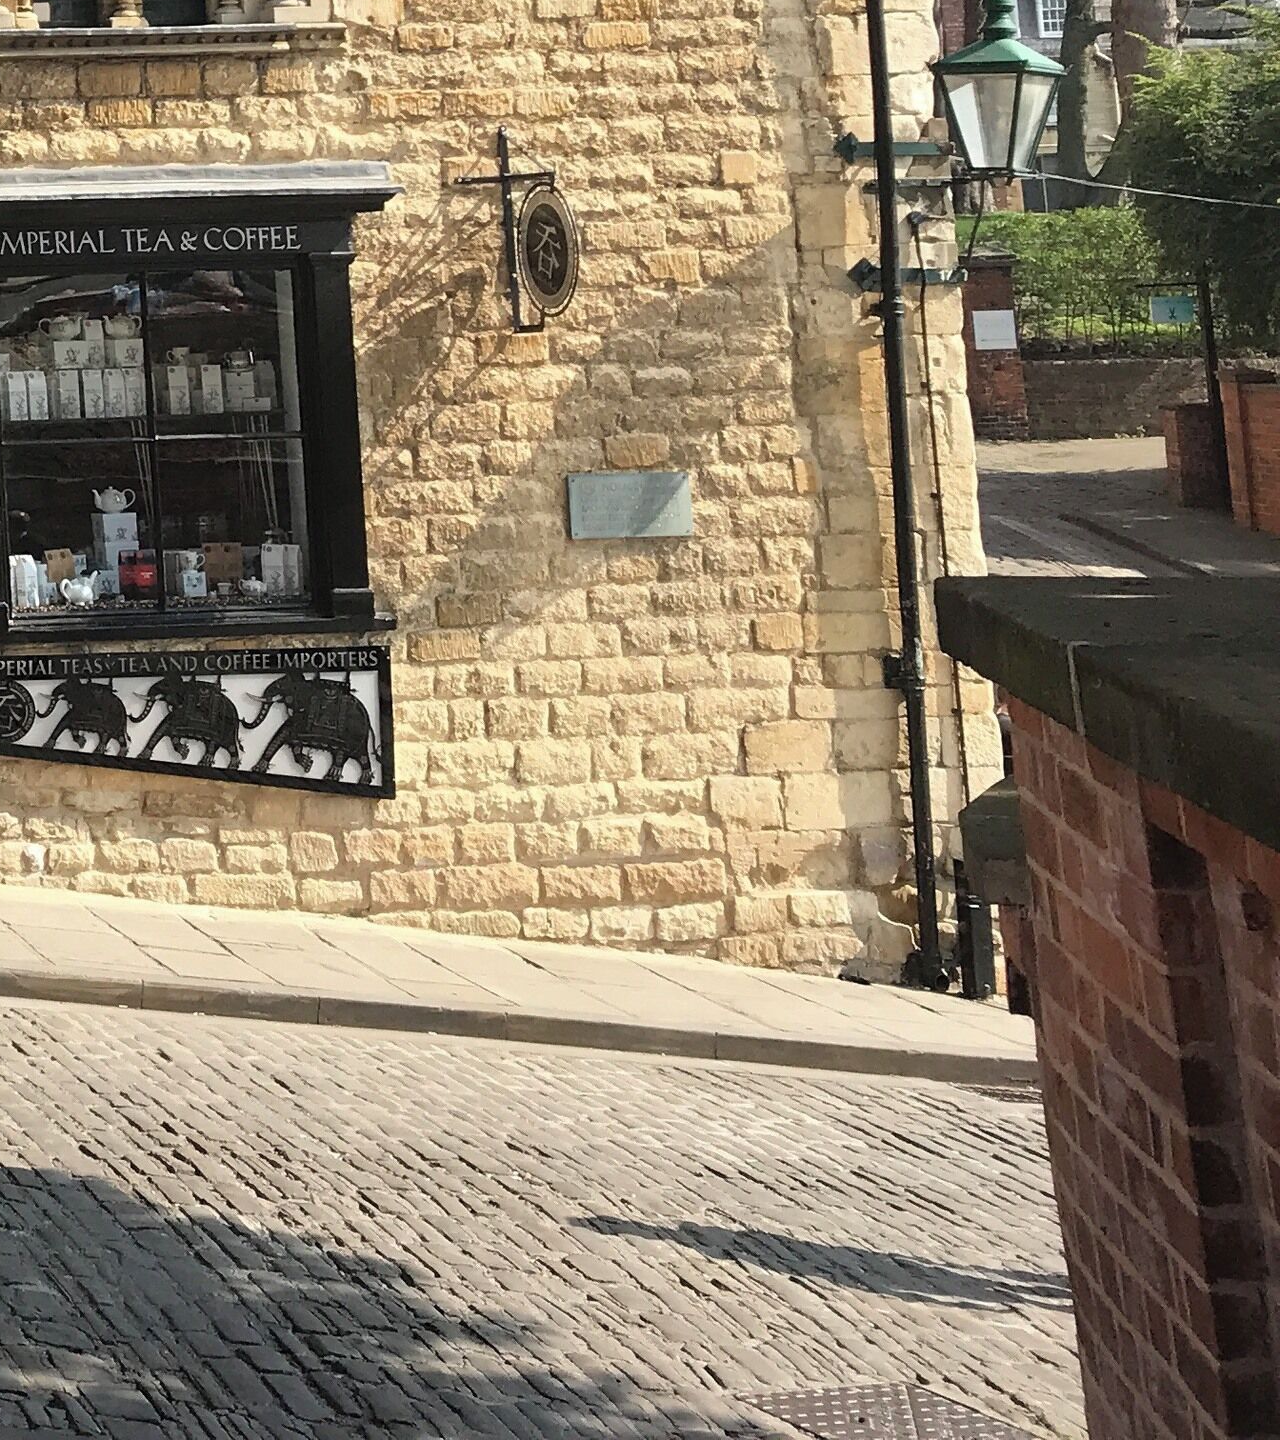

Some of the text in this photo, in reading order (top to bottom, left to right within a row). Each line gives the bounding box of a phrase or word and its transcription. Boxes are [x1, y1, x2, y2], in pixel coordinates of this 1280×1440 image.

[121, 228, 175, 253] TEA
[180, 231, 199, 252] &
[203, 225, 302, 252] COFFEE
[60, 657, 103, 675] TEAS
[117, 656, 152, 673] TEA
[156, 655, 198, 673] AND
[204, 653, 271, 672] COFFEE
[276, 650, 378, 670] IMPORTERS
